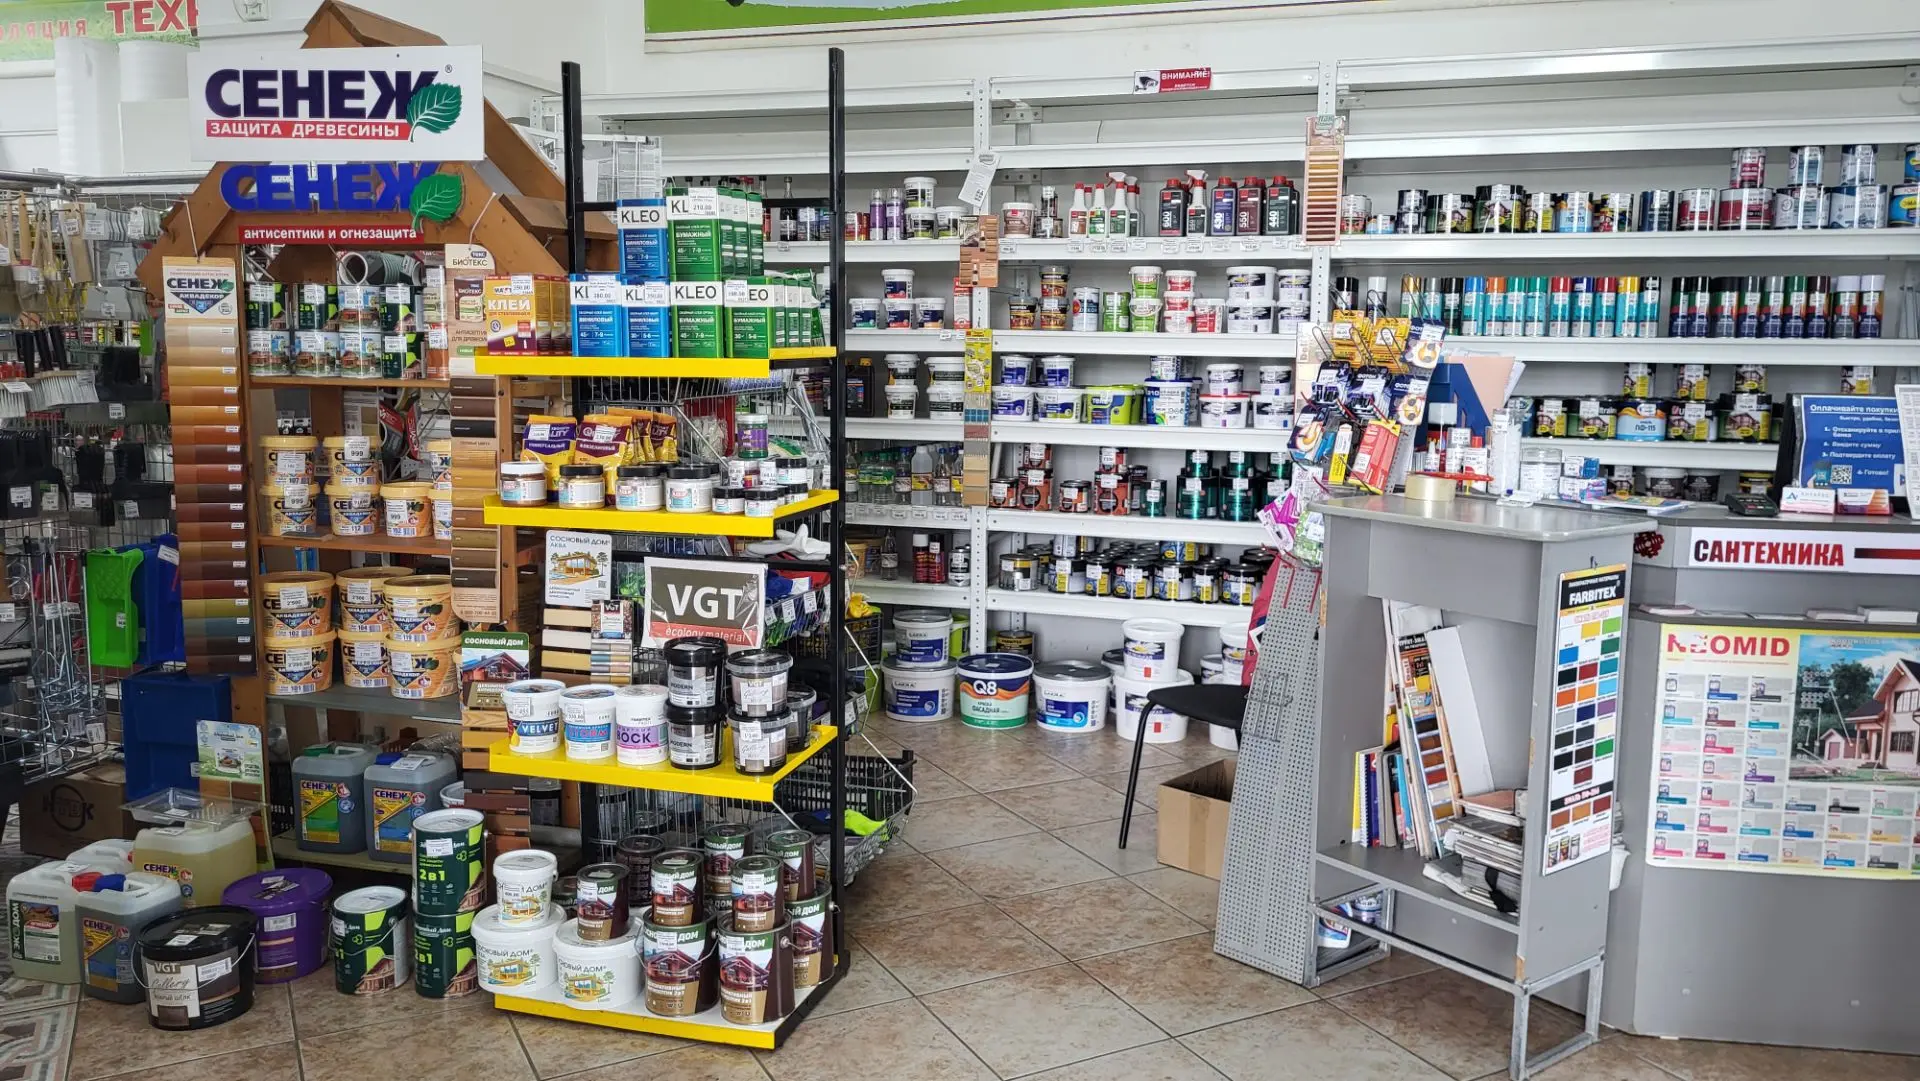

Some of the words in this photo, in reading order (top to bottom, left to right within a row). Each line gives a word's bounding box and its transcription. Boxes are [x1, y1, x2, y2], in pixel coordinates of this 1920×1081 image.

[205, 69, 438, 120] СЕНЕЖ
[211, 123, 281, 137] ЗАЩИТА
[292, 123, 400, 138] ДРЕВЕСИНЫ
[220, 163, 440, 212] СЕНЕЖ
[671, 200, 689, 213] KL
[621, 209, 660, 223] KLEO
[244, 229, 325, 240] антисептики
[328, 230, 336, 239] и
[342, 229, 417, 241] огнезащита
[452, 258, 488, 266] БИОТЕКС
[166, 277, 229, 290] СЕНЕЖ
[625, 289, 646, 301] KL
[675, 285, 717, 299] KLEO
[748, 289, 769, 301] EO
[487, 299, 531, 311] КЛЕЙ
[550, 535, 590, 544] СОСНОВЫЙ
[1694, 539, 1844, 566] САНТЕХНИКА
[667, 583, 743, 620] VGT
[1569, 586, 1617, 606] FARBITEX
[464, 636, 507, 646] СОСНОВЫЙ
[973, 680, 997, 696] Q8
[522, 722, 559, 734] VELVET
[301, 781, 334, 791] СЕНЕЖ
[374, 789, 408, 799] СЕНЕЖ
[144, 863, 177, 874] СЕНЕЖ
[525, 884, 545, 894] ДОМ
[599, 885, 615, 894] ДОМ
[801, 903, 820, 916] ДОМ
[83, 919, 114, 930] СЕНЕЖ
[678, 930, 699, 942] ДОМ
[744, 938, 766, 949] ДОМ
[510, 949, 530, 957] ДОМ
[154, 962, 178, 973] VGT
